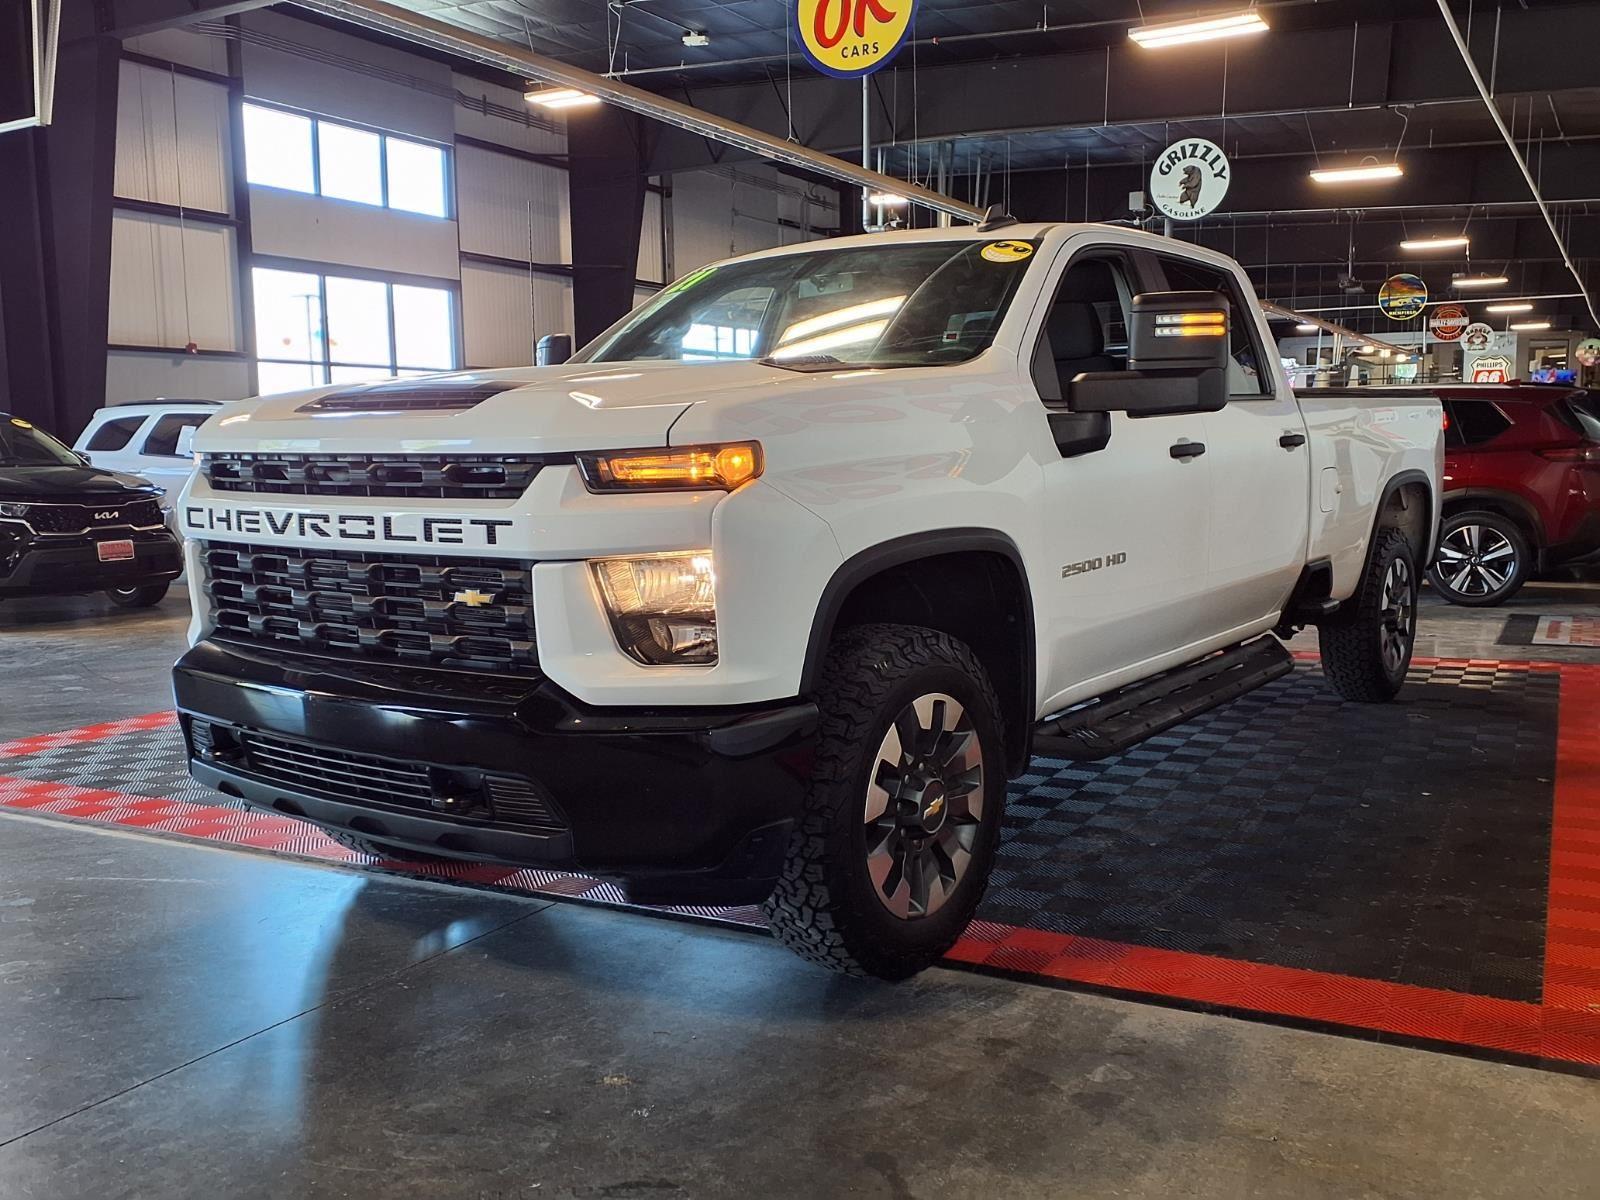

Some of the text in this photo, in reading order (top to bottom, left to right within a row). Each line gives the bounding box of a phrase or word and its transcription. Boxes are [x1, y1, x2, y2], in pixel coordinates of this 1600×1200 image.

[814, 0, 896, 48] OK
[841, 42, 879, 58] CARS
[1158, 143, 1227, 180] GRIZZLY
[1162, 203, 1206, 217] GASOLINE
[1477, 371, 1502, 383] 66
[95, 511, 119, 519] KIA
[187, 506, 513, 545] CHEVROLET
[1062, 552, 1126, 579] 2500 HD
